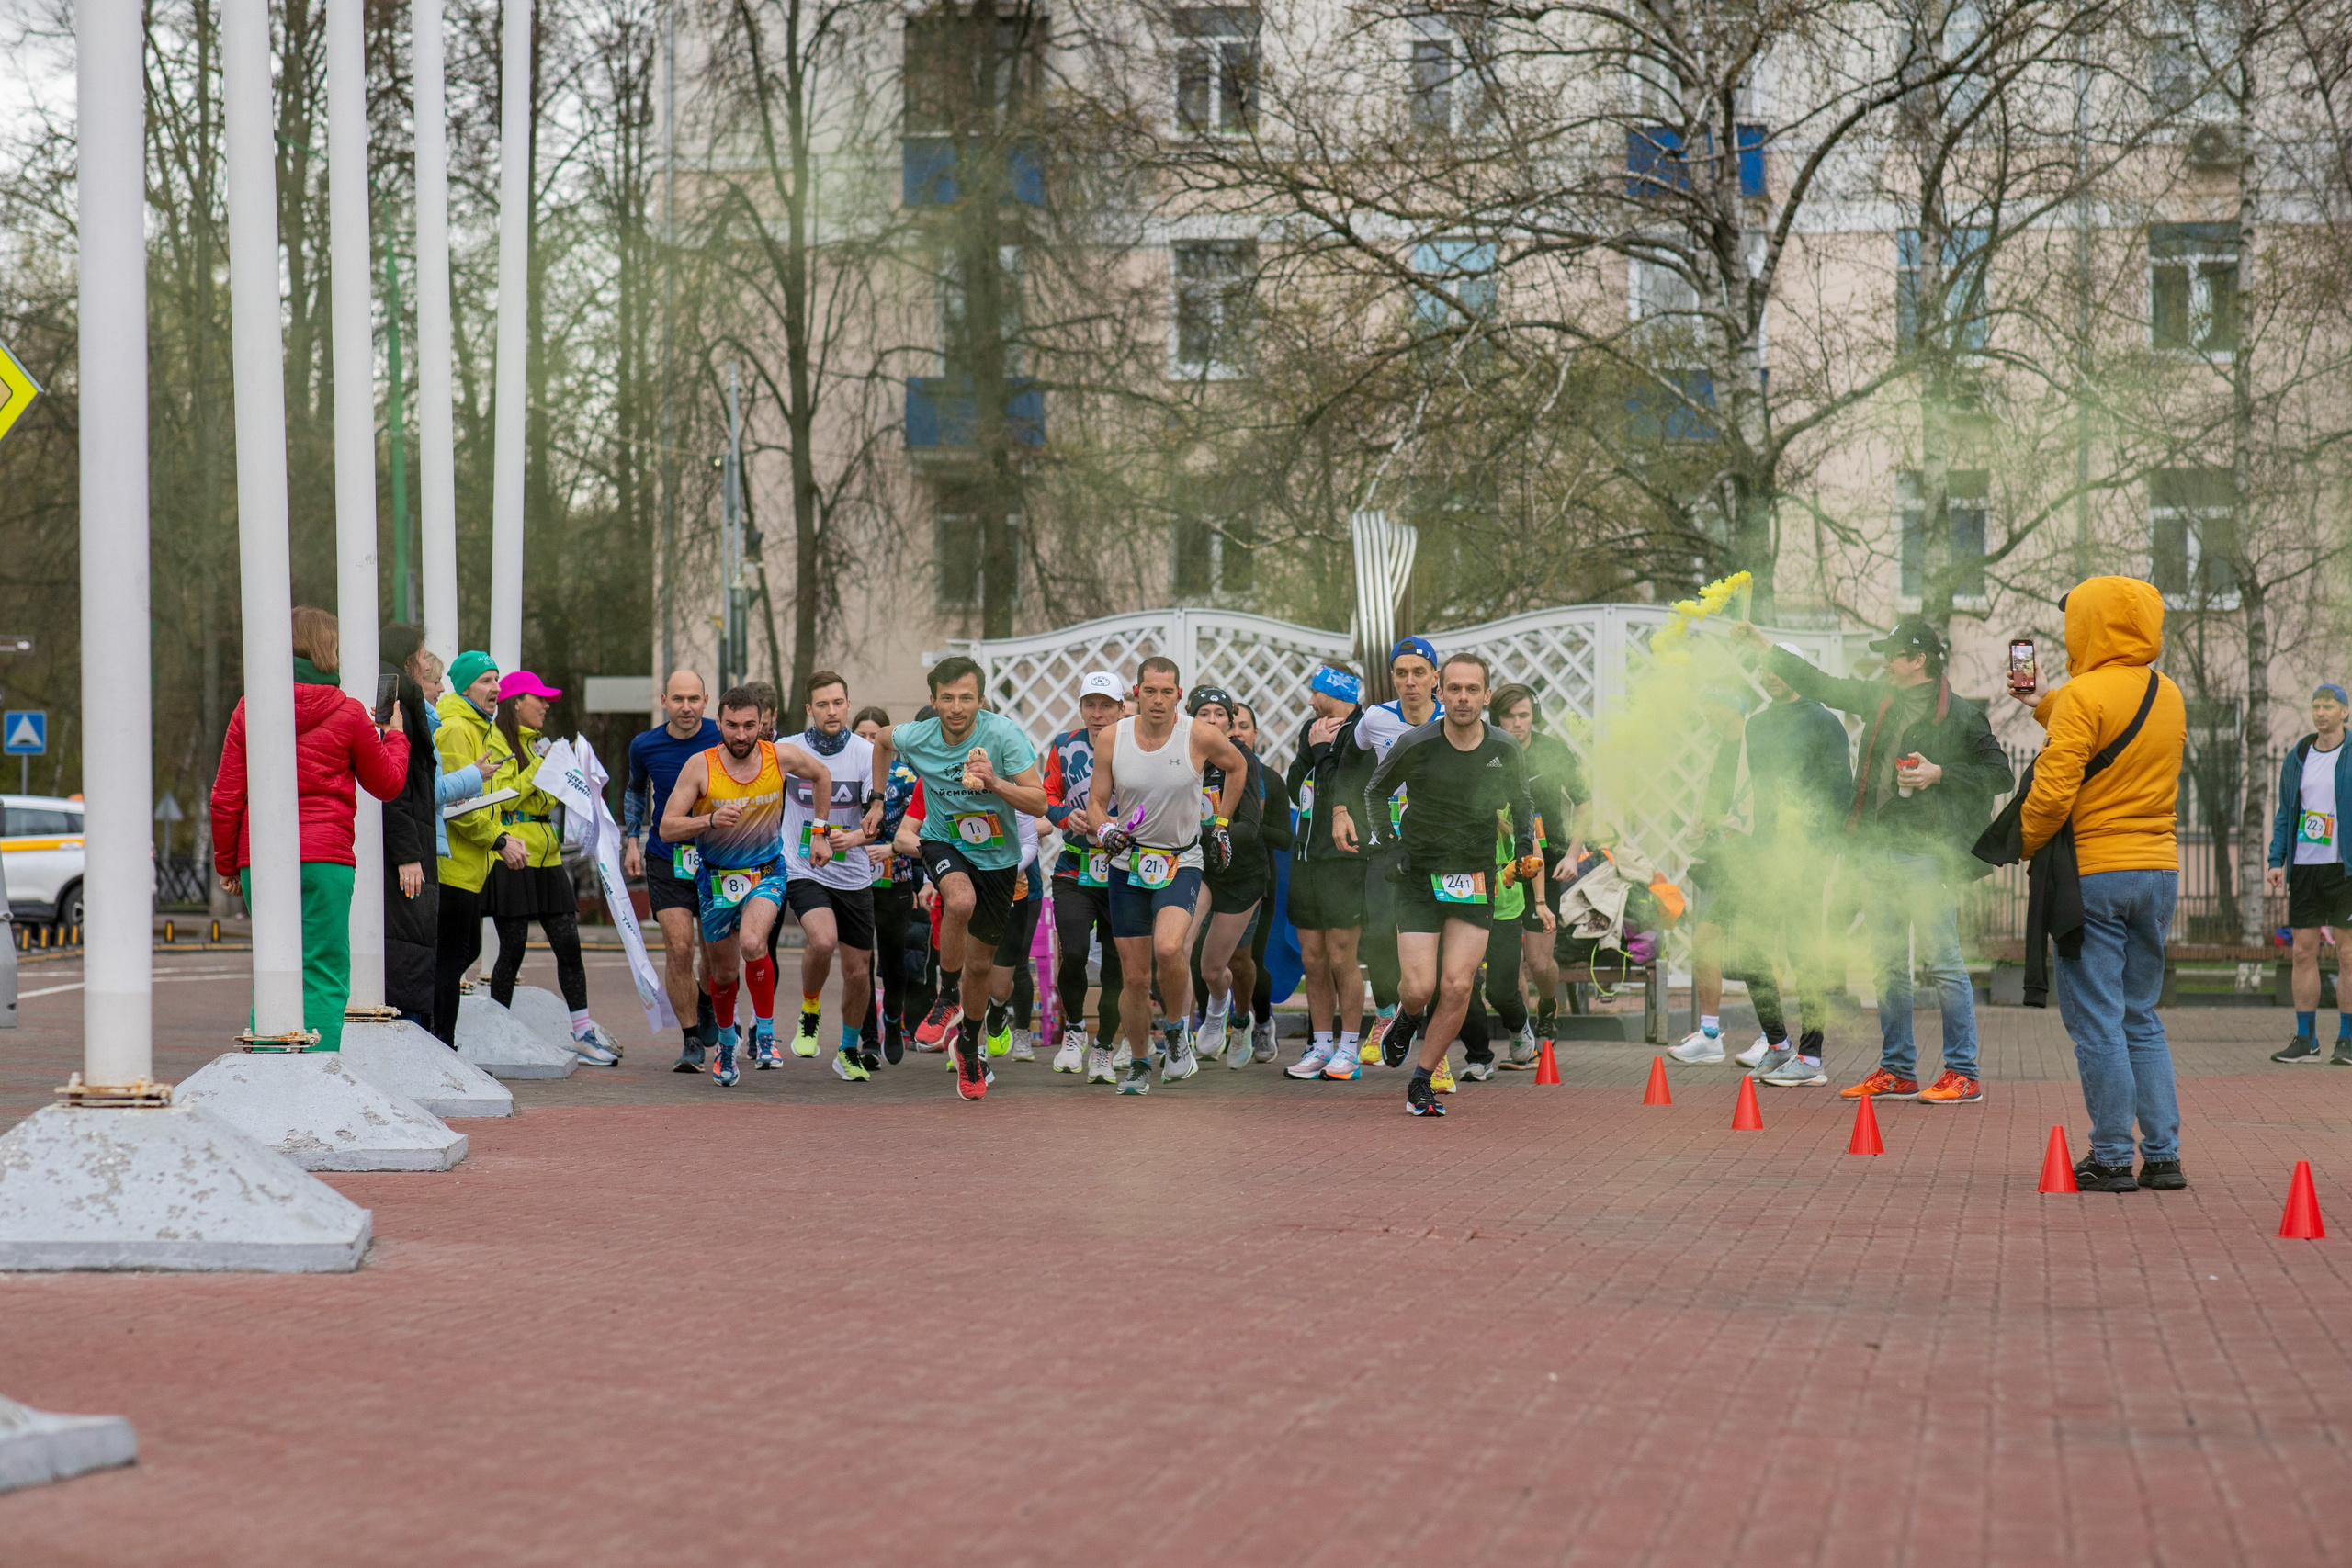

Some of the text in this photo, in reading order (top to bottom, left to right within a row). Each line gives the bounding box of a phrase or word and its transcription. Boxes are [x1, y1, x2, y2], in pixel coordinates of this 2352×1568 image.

[565, 771, 591, 792] DREA
[711, 796, 750, 808] WAKE
[755, 790, 780, 806] RUN
